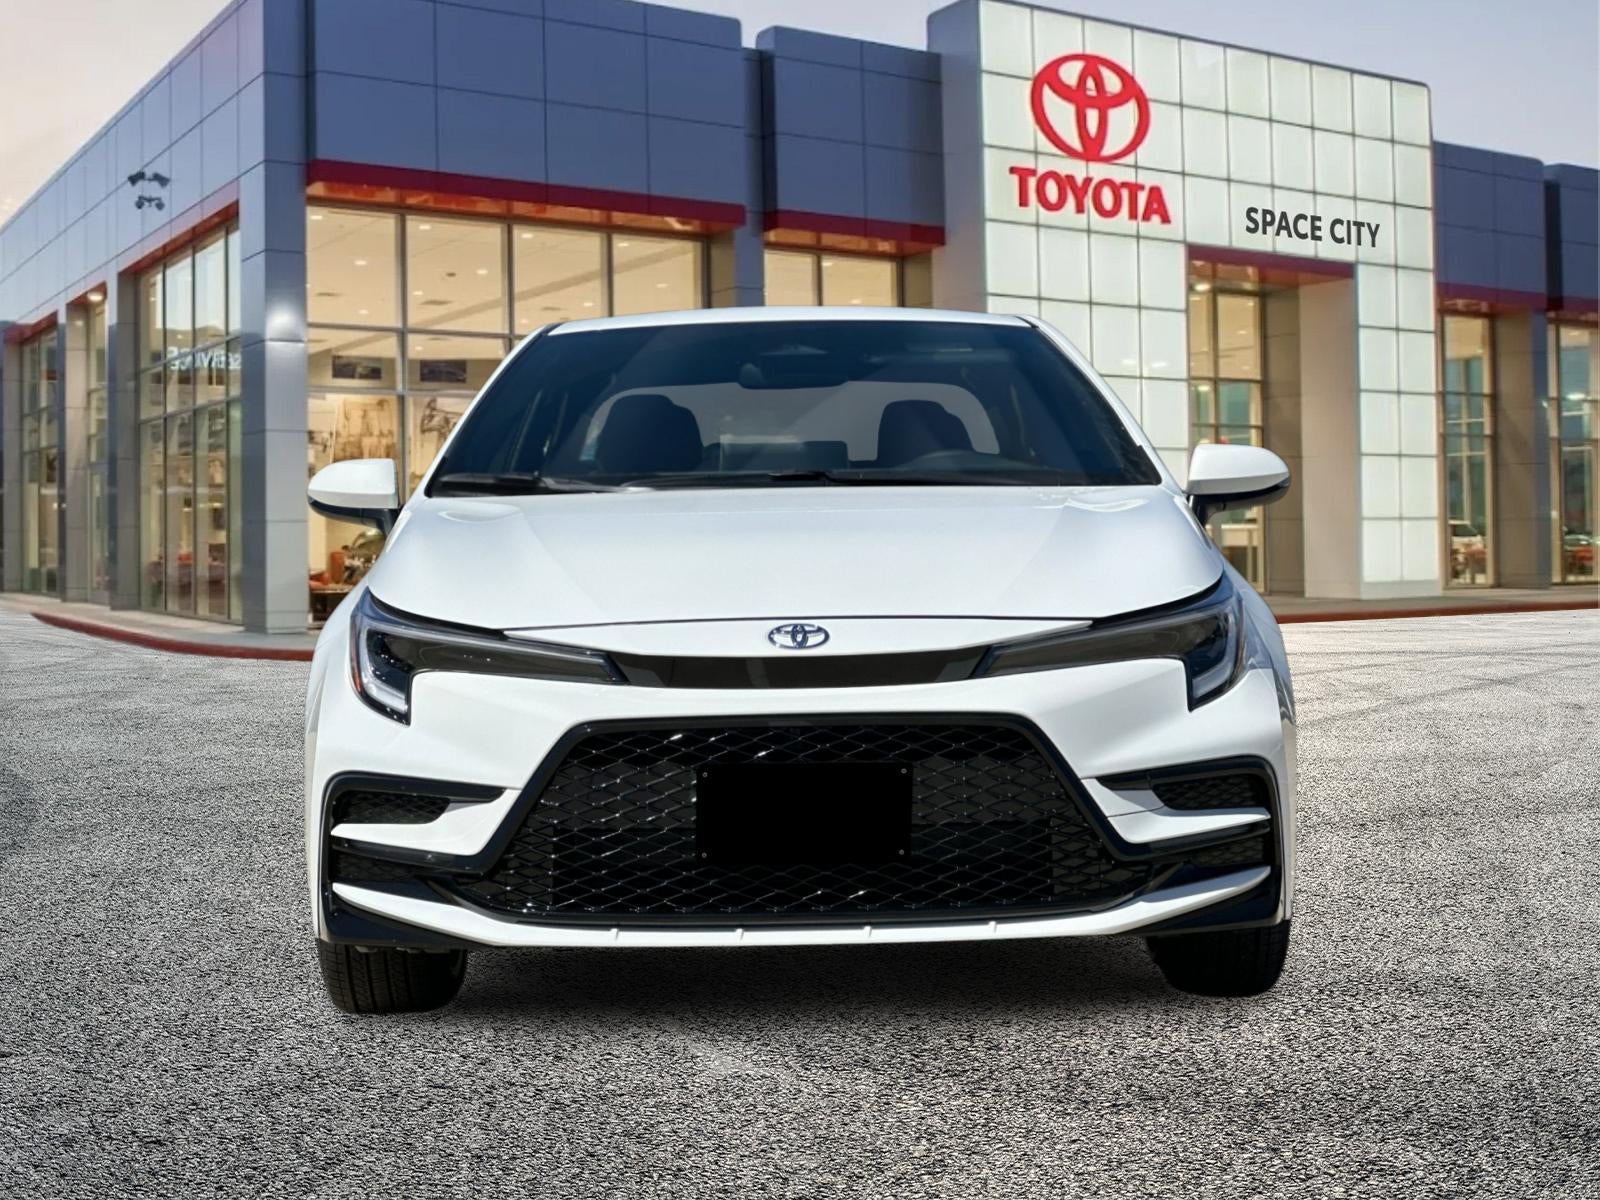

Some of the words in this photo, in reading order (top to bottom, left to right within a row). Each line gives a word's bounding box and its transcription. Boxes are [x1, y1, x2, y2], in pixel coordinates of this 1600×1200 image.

[1009, 166, 1171, 224] TOYOTA
[1245, 206, 1322, 241] SPACE
[1329, 218, 1380, 247] CITY
